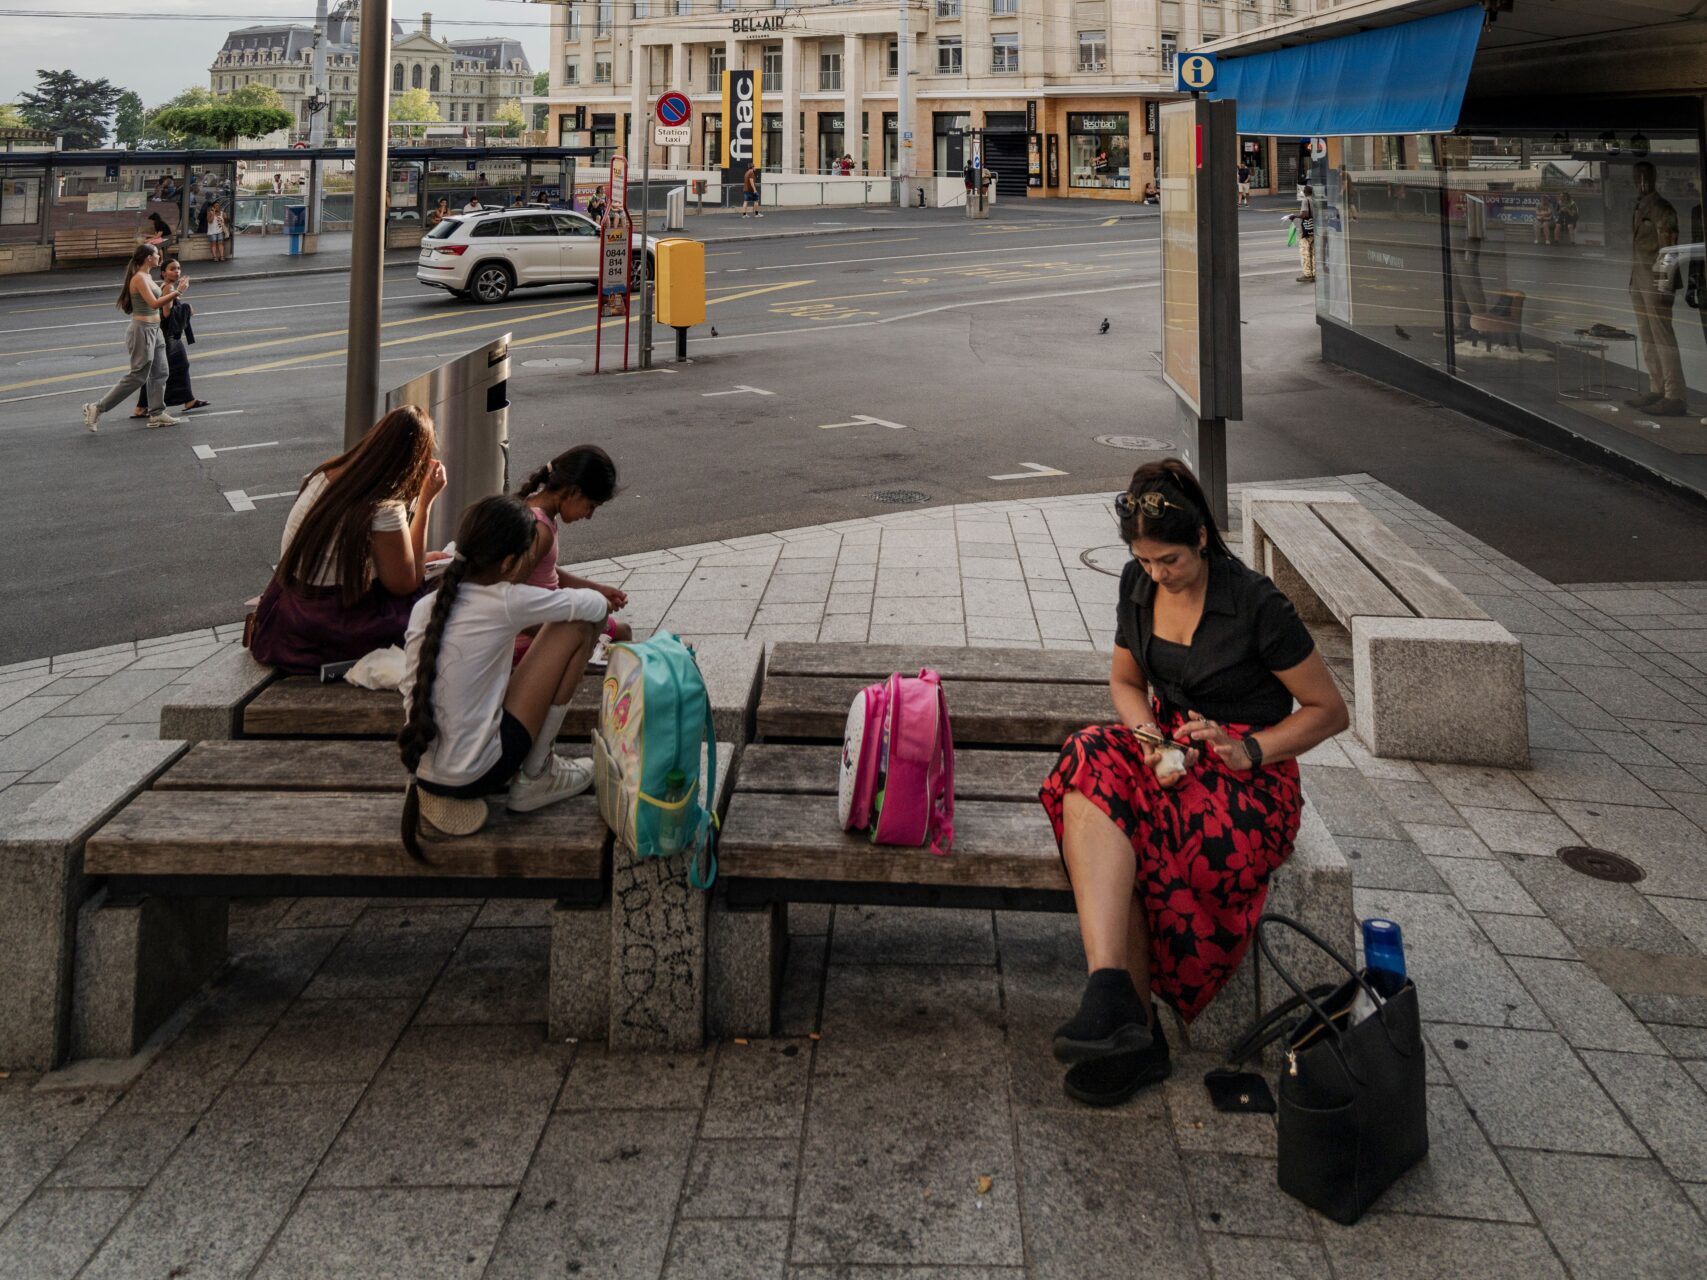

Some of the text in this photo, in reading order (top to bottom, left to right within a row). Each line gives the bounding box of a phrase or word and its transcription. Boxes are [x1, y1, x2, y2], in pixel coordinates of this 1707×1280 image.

[730, 77, 753, 161] fnac
[658, 128, 688, 136] Station
[605, 249, 626, 257] 0844
[608, 258, 622, 267] 814
[608, 268, 622, 276] 814
